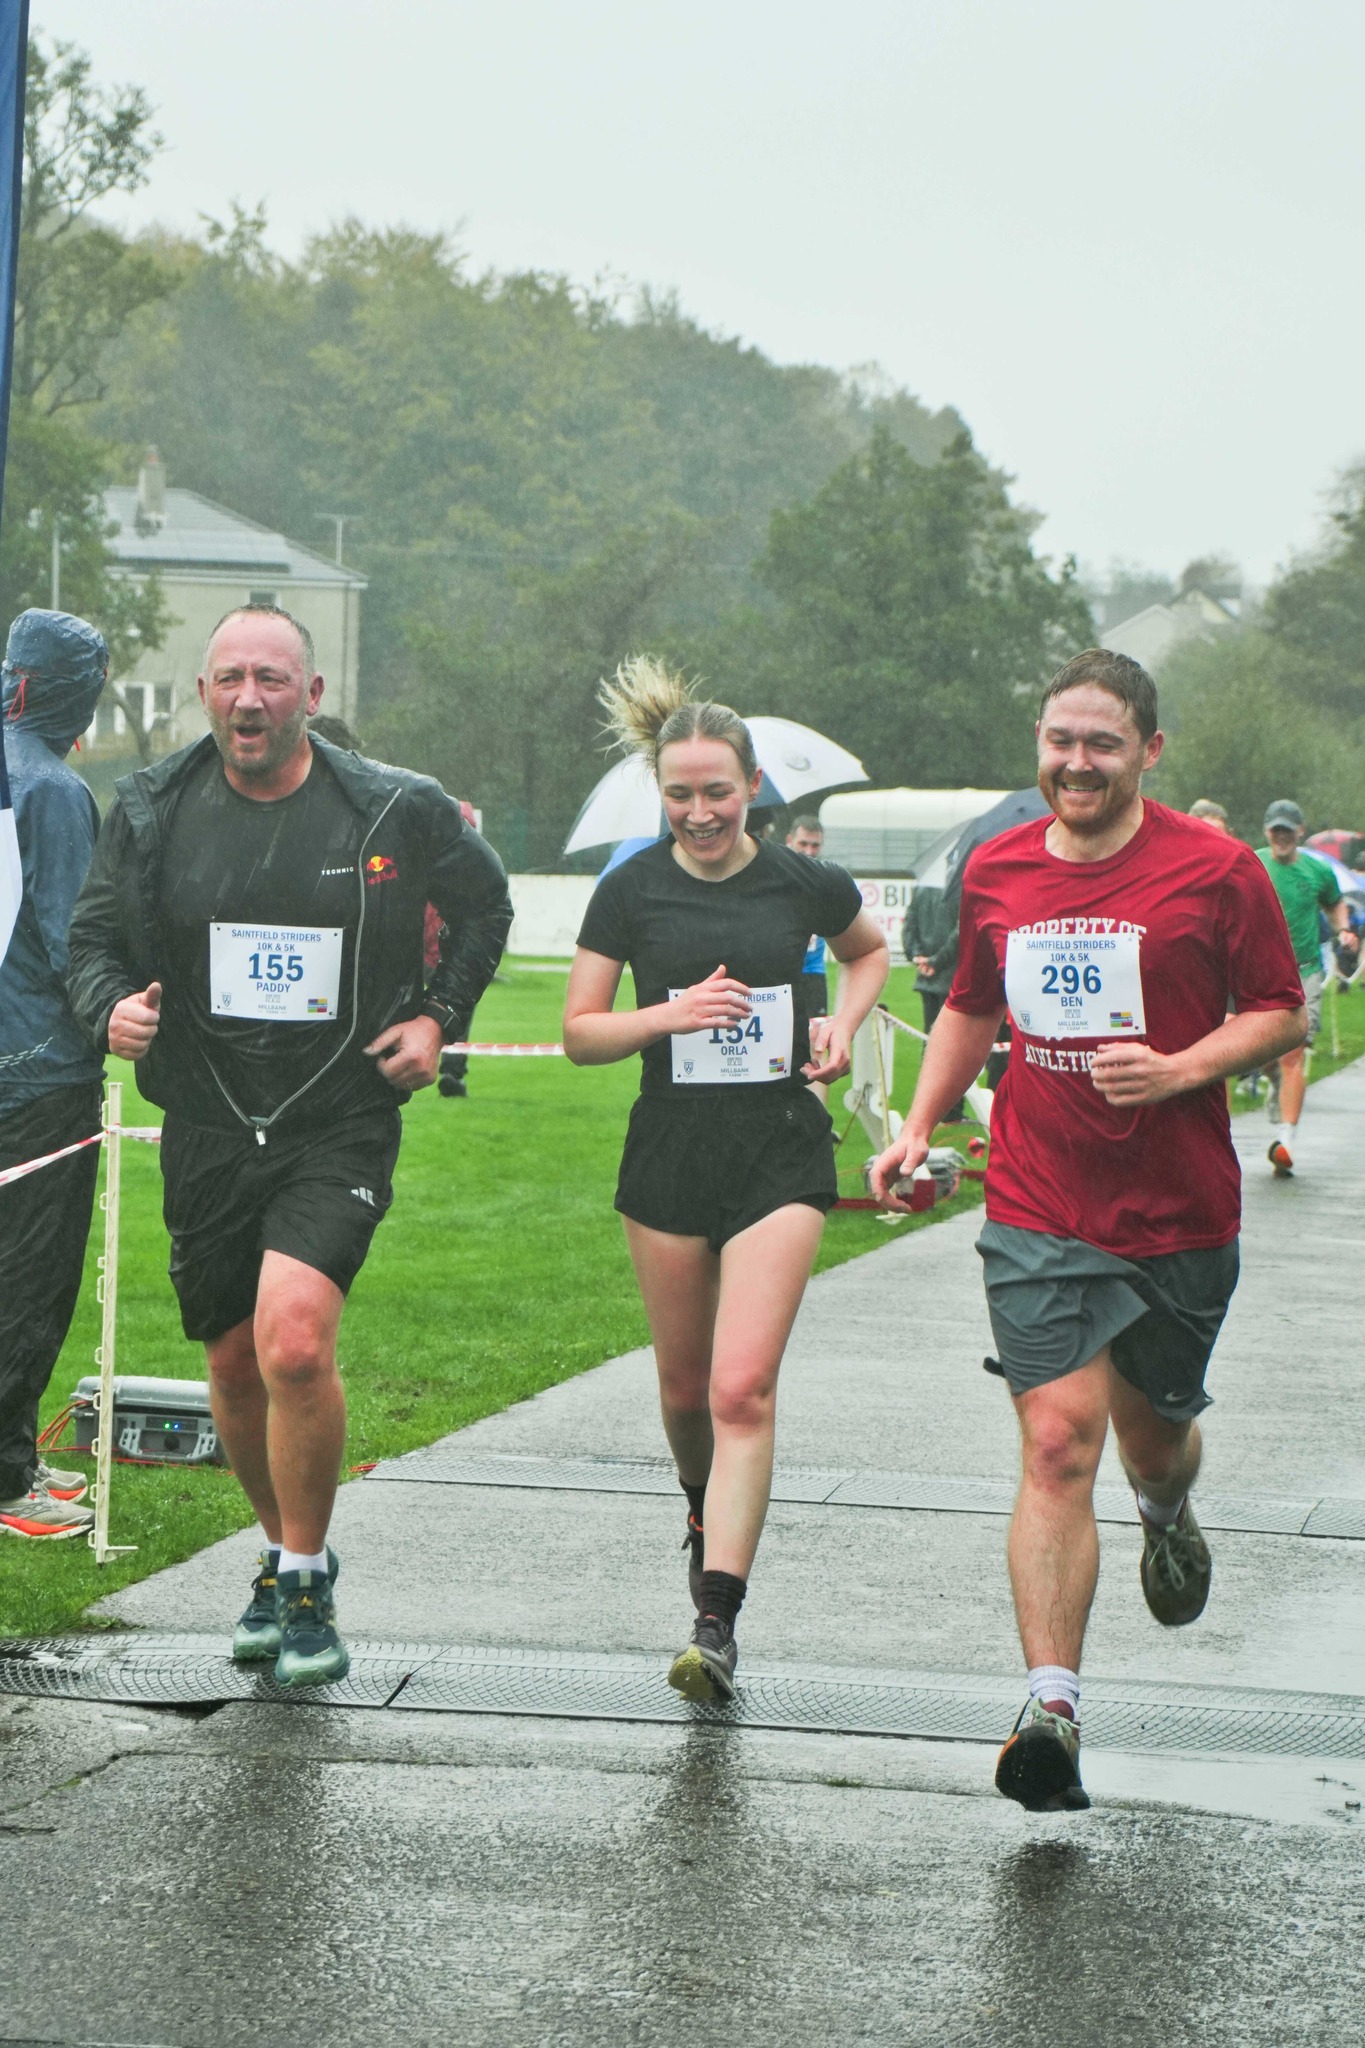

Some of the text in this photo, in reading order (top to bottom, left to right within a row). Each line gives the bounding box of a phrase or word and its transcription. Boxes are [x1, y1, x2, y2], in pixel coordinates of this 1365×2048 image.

[1009, 917, 1115, 935] OPERTY
[231, 928, 322, 942] SAINTFIELD STRIDERS
[256, 942, 273, 951] 10K
[284, 944, 295, 952] 5K
[1026, 940, 1117, 950] SAINTFIELD STRIDERS
[1050, 953, 1090, 962] 10K & 5K
[248, 952, 304, 982] 155
[1041, 964, 1102, 995] 296
[256, 982, 291, 993] PADDY
[1060, 996, 1083, 1007] BEN
[708, 1016, 764, 1044] 154
[720, 1046, 748, 1056] ORLA
